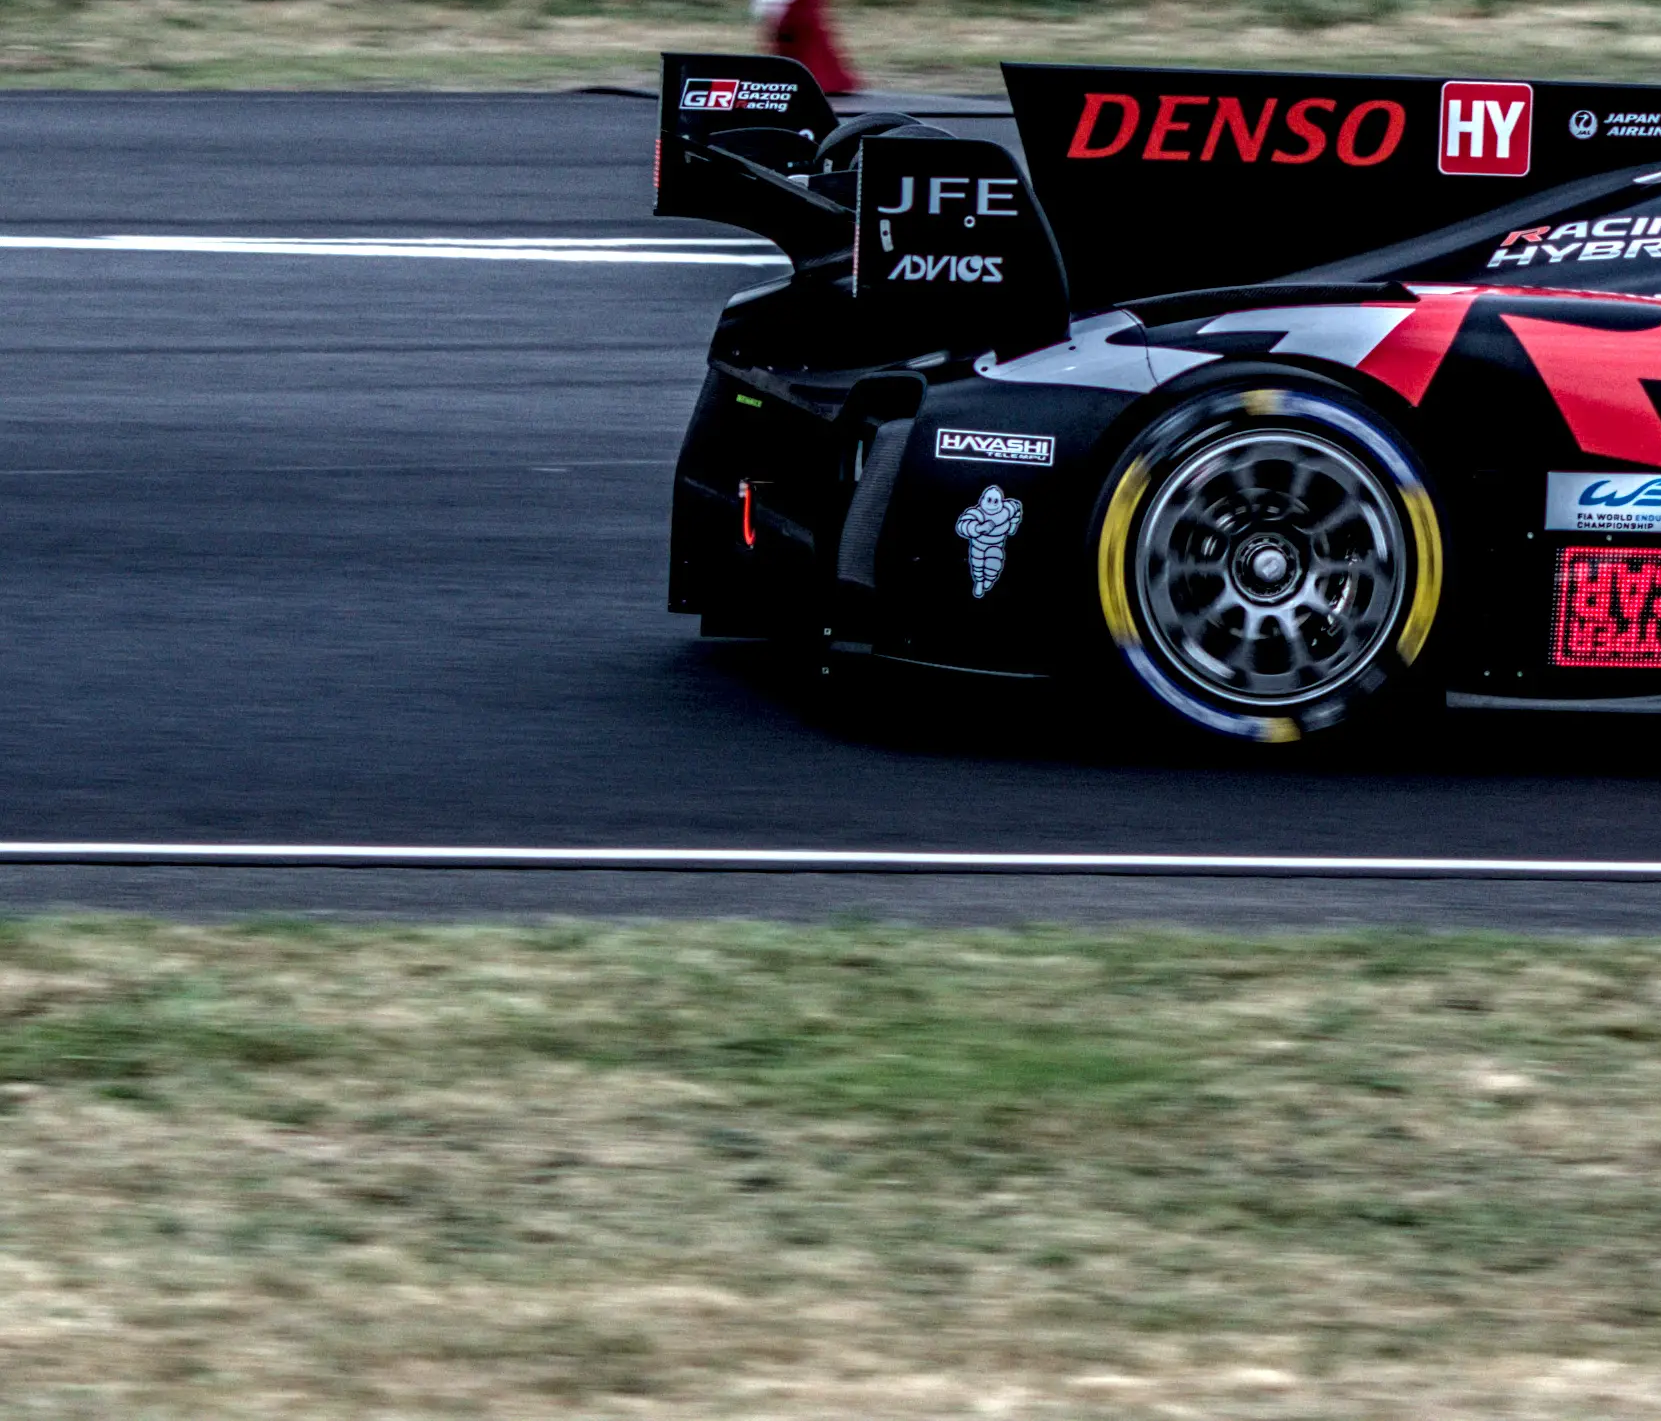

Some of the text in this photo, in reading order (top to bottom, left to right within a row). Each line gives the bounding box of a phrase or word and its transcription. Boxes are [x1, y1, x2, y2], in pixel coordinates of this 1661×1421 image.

[740, 81, 798, 91] TOYOTA
[684, 91, 733, 108] GR
[738, 91, 791, 100] GAZOO
[735, 101, 789, 112] Racing
[1603, 113, 1661, 124] JAPAN
[1067, 93, 1406, 166] DENSO
[1446, 99, 1525, 158] HY
[877, 177, 1018, 216] JFE
[940, 434, 1049, 455] HAYASHI
[1577, 513, 1594, 521] FIA
[1576, 521, 1654, 529] CHAMPIONSHIP
